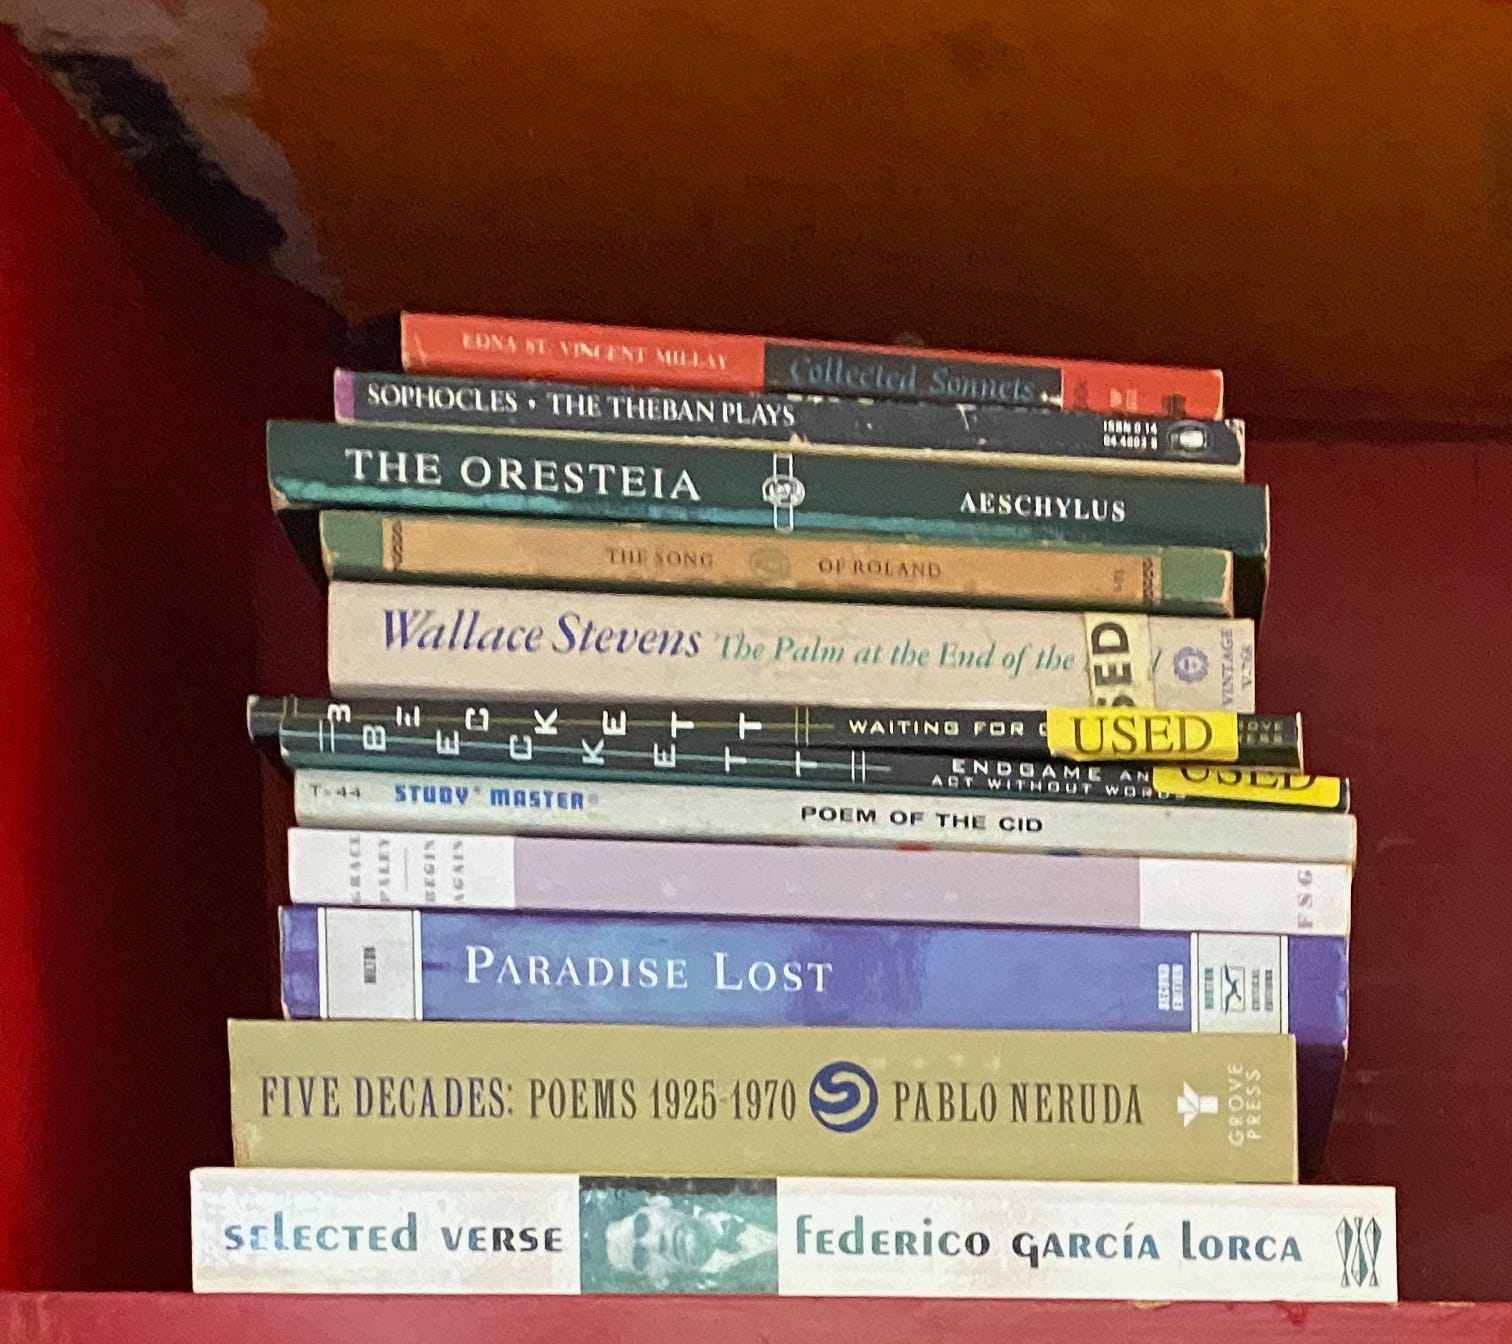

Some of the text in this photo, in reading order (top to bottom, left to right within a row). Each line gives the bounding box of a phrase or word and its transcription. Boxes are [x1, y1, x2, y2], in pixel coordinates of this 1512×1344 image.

[367, 383, 795, 426] SOPHOCLES THE THEBAN PLAYS
[345, 448, 700, 499] THE ORESTEIA
[960, 491, 1125, 522] AESCHYLUS
[383, 609, 702, 658] Wallace Stevens
[849, 719, 1024, 737] WAITING FOR
[1071, 715, 1212, 755] USED
[952, 759, 1101, 781] ENDGAME
[801, 806, 1043, 832] POEM OF THE CID
[261, 1076, 796, 1121] FIVE DECADES: POEMS 1925-1970
[894, 1080, 1144, 1124] PABLO NERUDA
[1228, 1062, 1244, 1145] GROVE
[1247, 1069, 1262, 1140] PRESS
